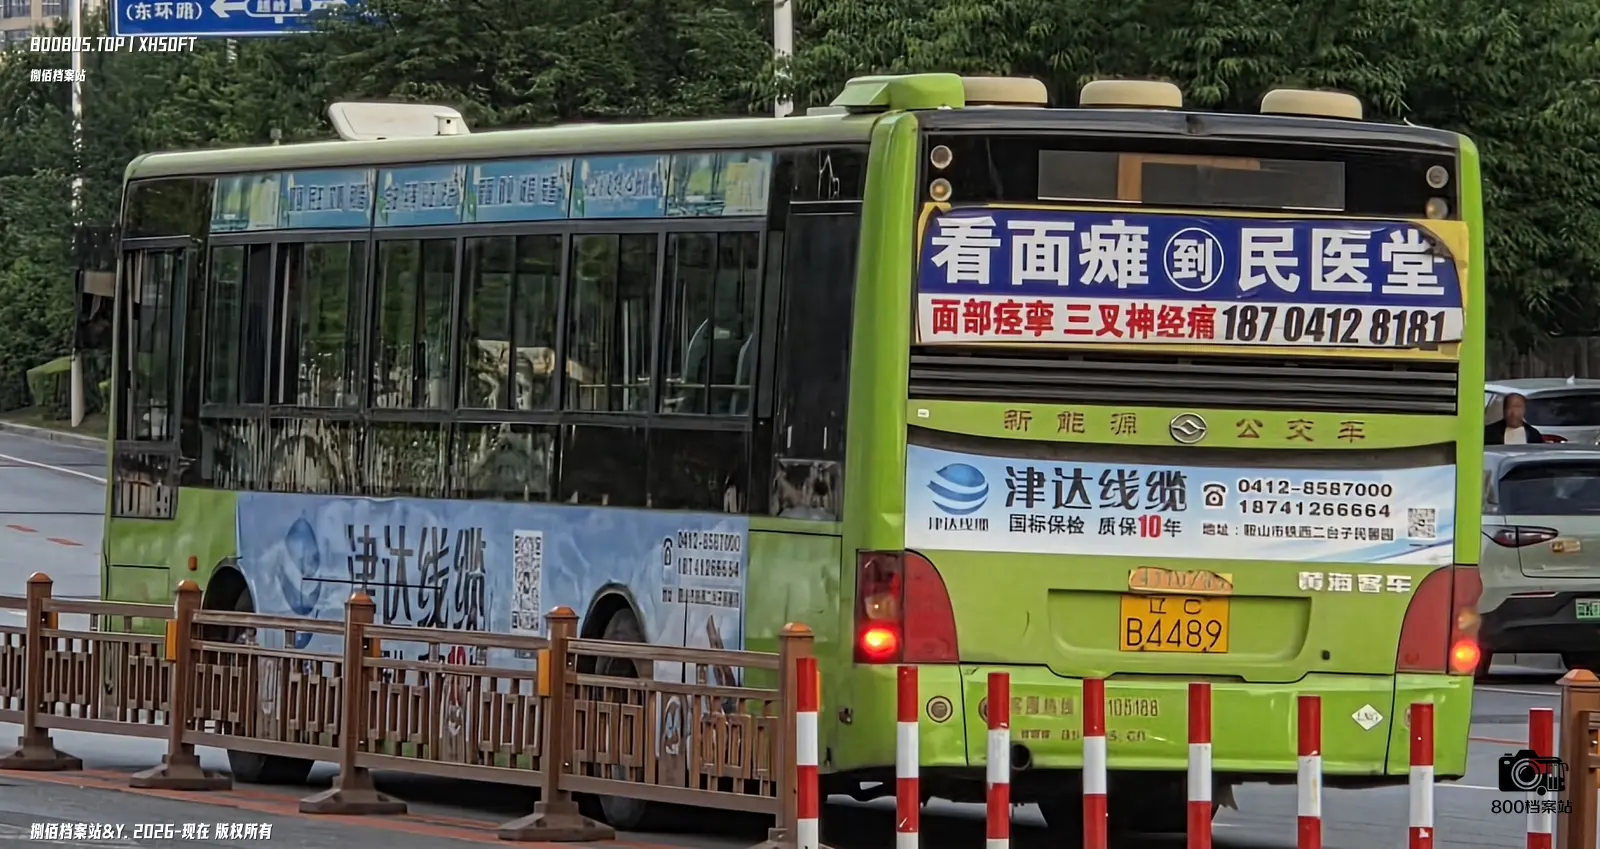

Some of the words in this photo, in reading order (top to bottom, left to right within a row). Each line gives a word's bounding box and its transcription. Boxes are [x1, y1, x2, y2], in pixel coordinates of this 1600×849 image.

[930, 215, 1150, 290] 看面瘫
[1237, 226, 1446, 296] 民医堂
[1063, 303, 1217, 341] 三叉神经痛
[1222, 305, 1277, 342] 187
[1283, 307, 1362, 343] 0412
[1369, 309, 1446, 348] 8181
[1003, 409, 1138, 435] 新能源
[1235, 418, 1367, 443] 公交车
[1004, 466, 1189, 512] 津达线缆
[1238, 478, 1393, 498] 0412-8587000
[1239, 499, 1392, 518] 18741266664
[1009, 513, 1085, 535] 国标保检
[1097, 514, 1182, 538] 质保10年
[1126, 617, 1223, 649] B4489
